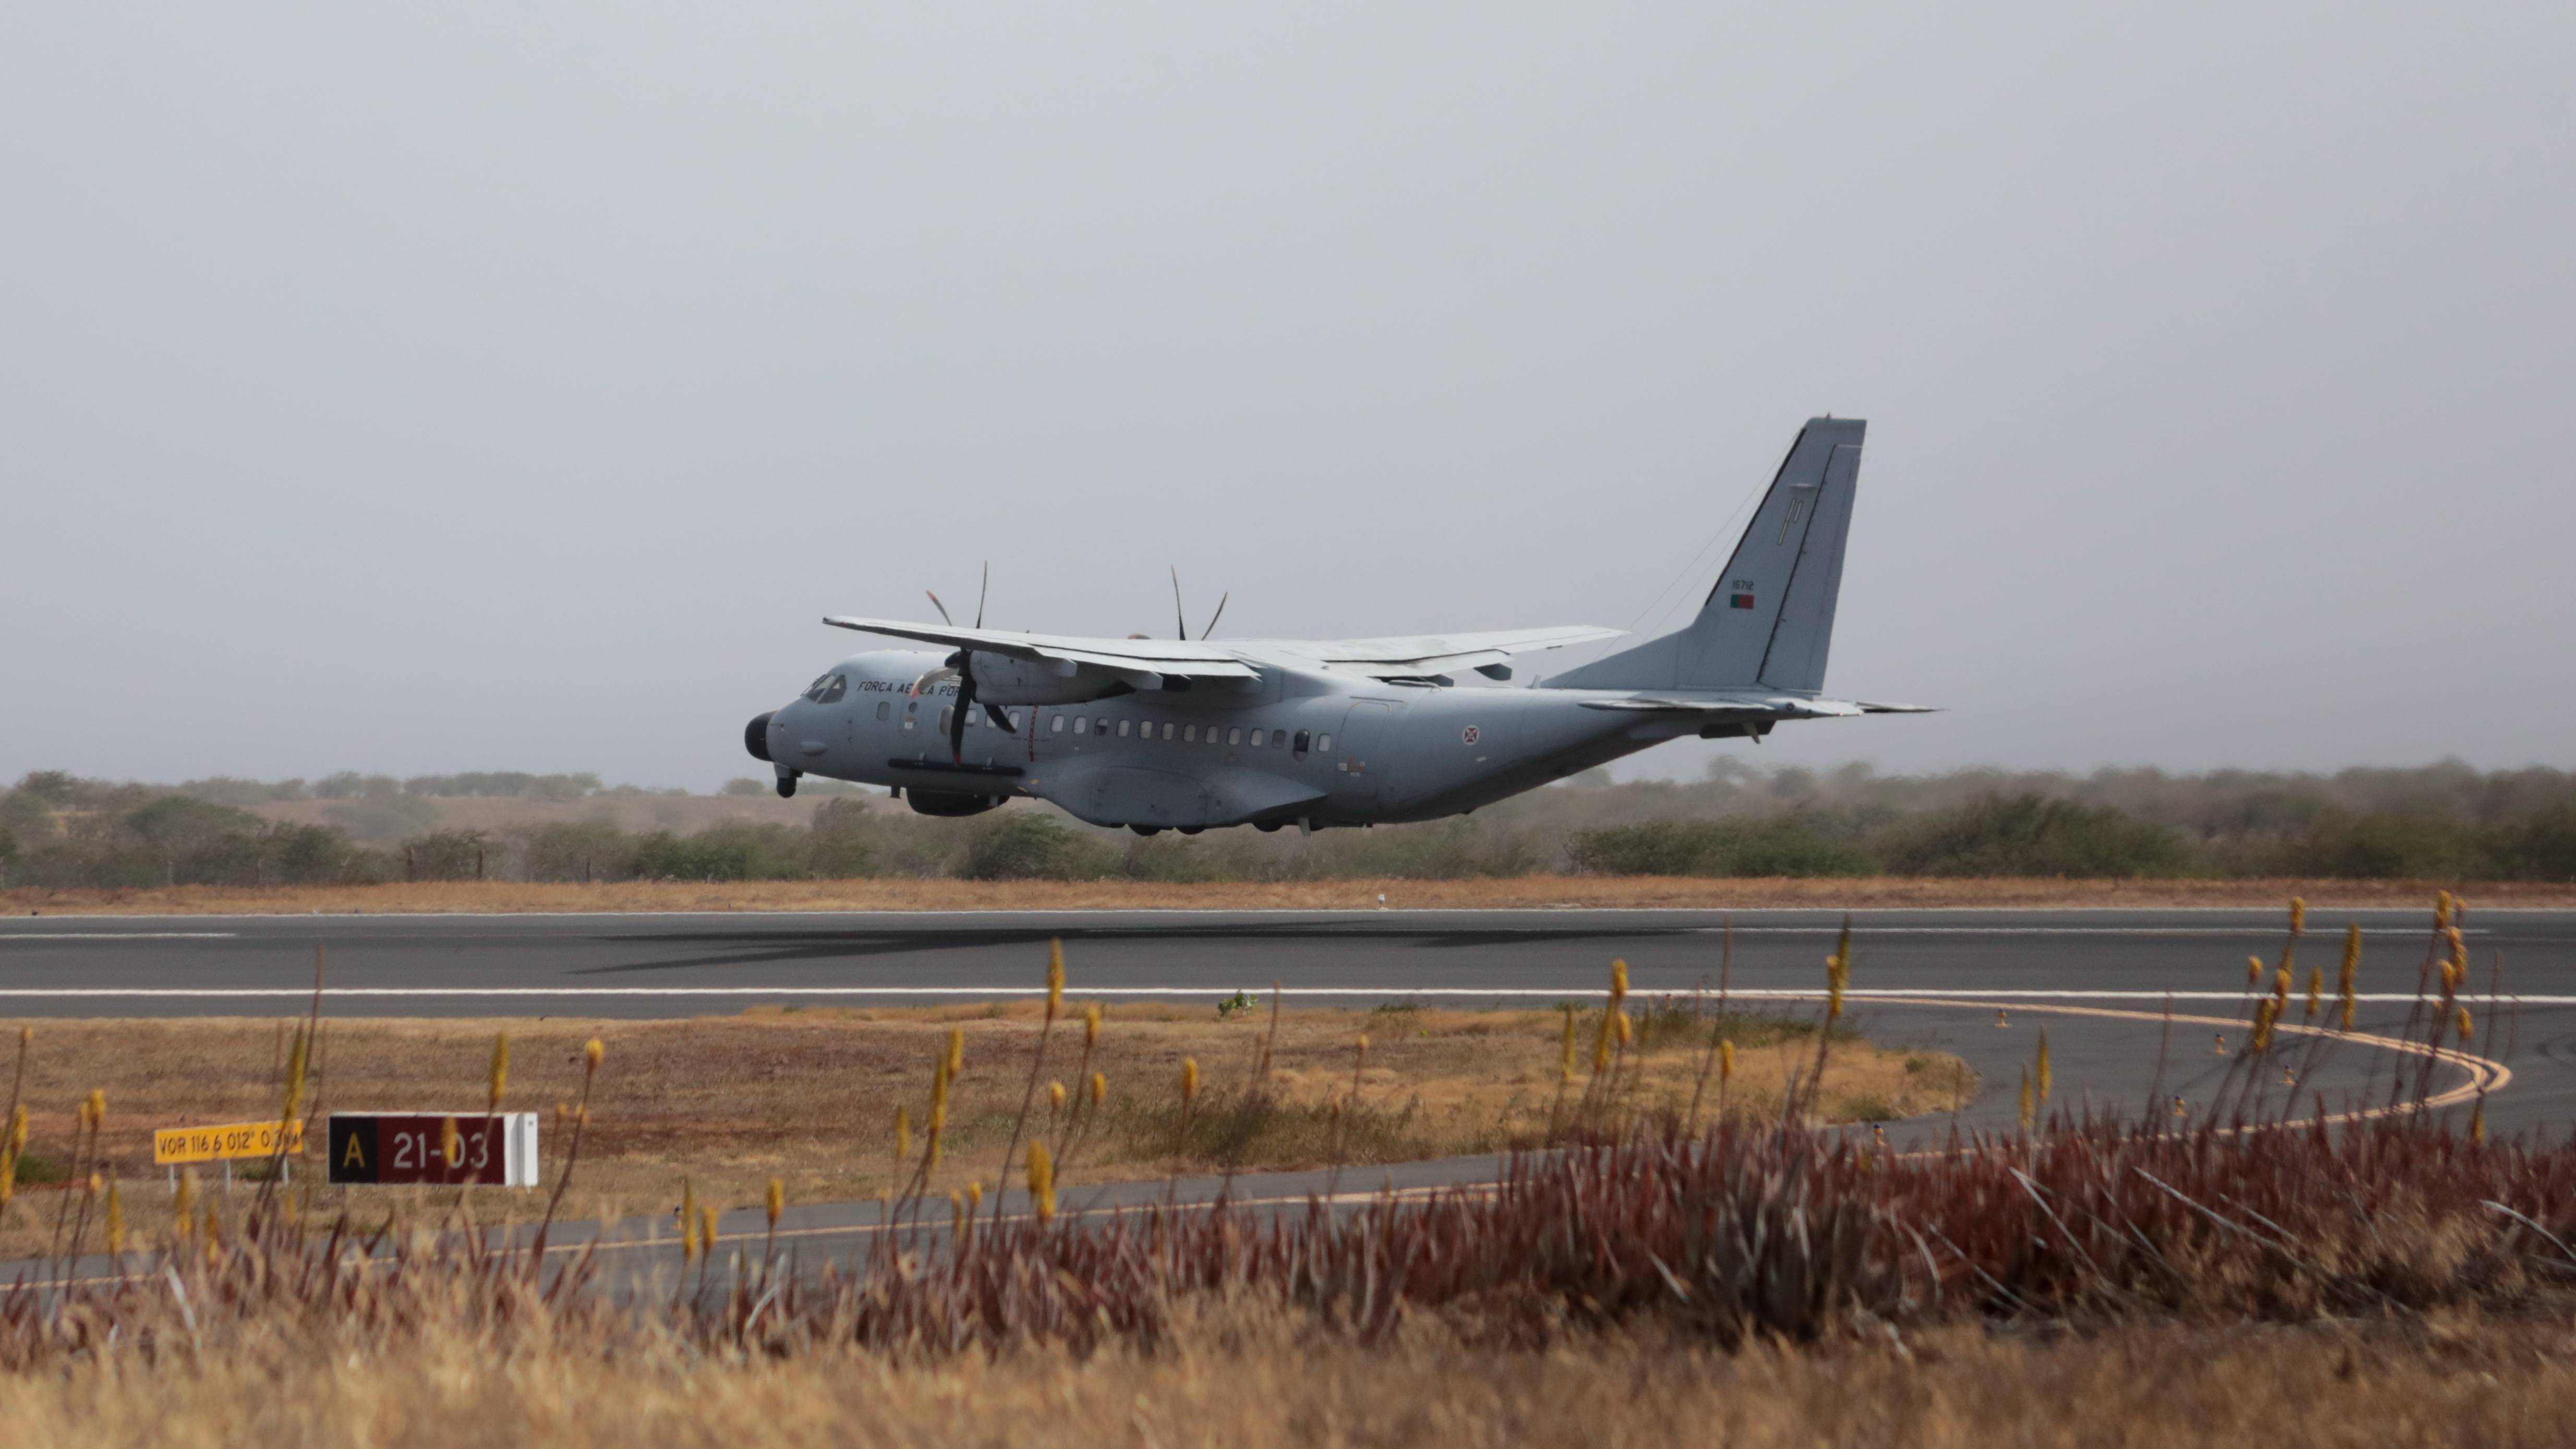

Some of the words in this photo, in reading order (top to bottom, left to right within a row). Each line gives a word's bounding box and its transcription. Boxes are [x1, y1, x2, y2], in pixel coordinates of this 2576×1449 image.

[857, 681, 893, 693] FORÇA
[159, 1137, 186, 1155] VOR
[343, 1131, 366, 1168] A
[393, 1131, 489, 1169] 21-03
